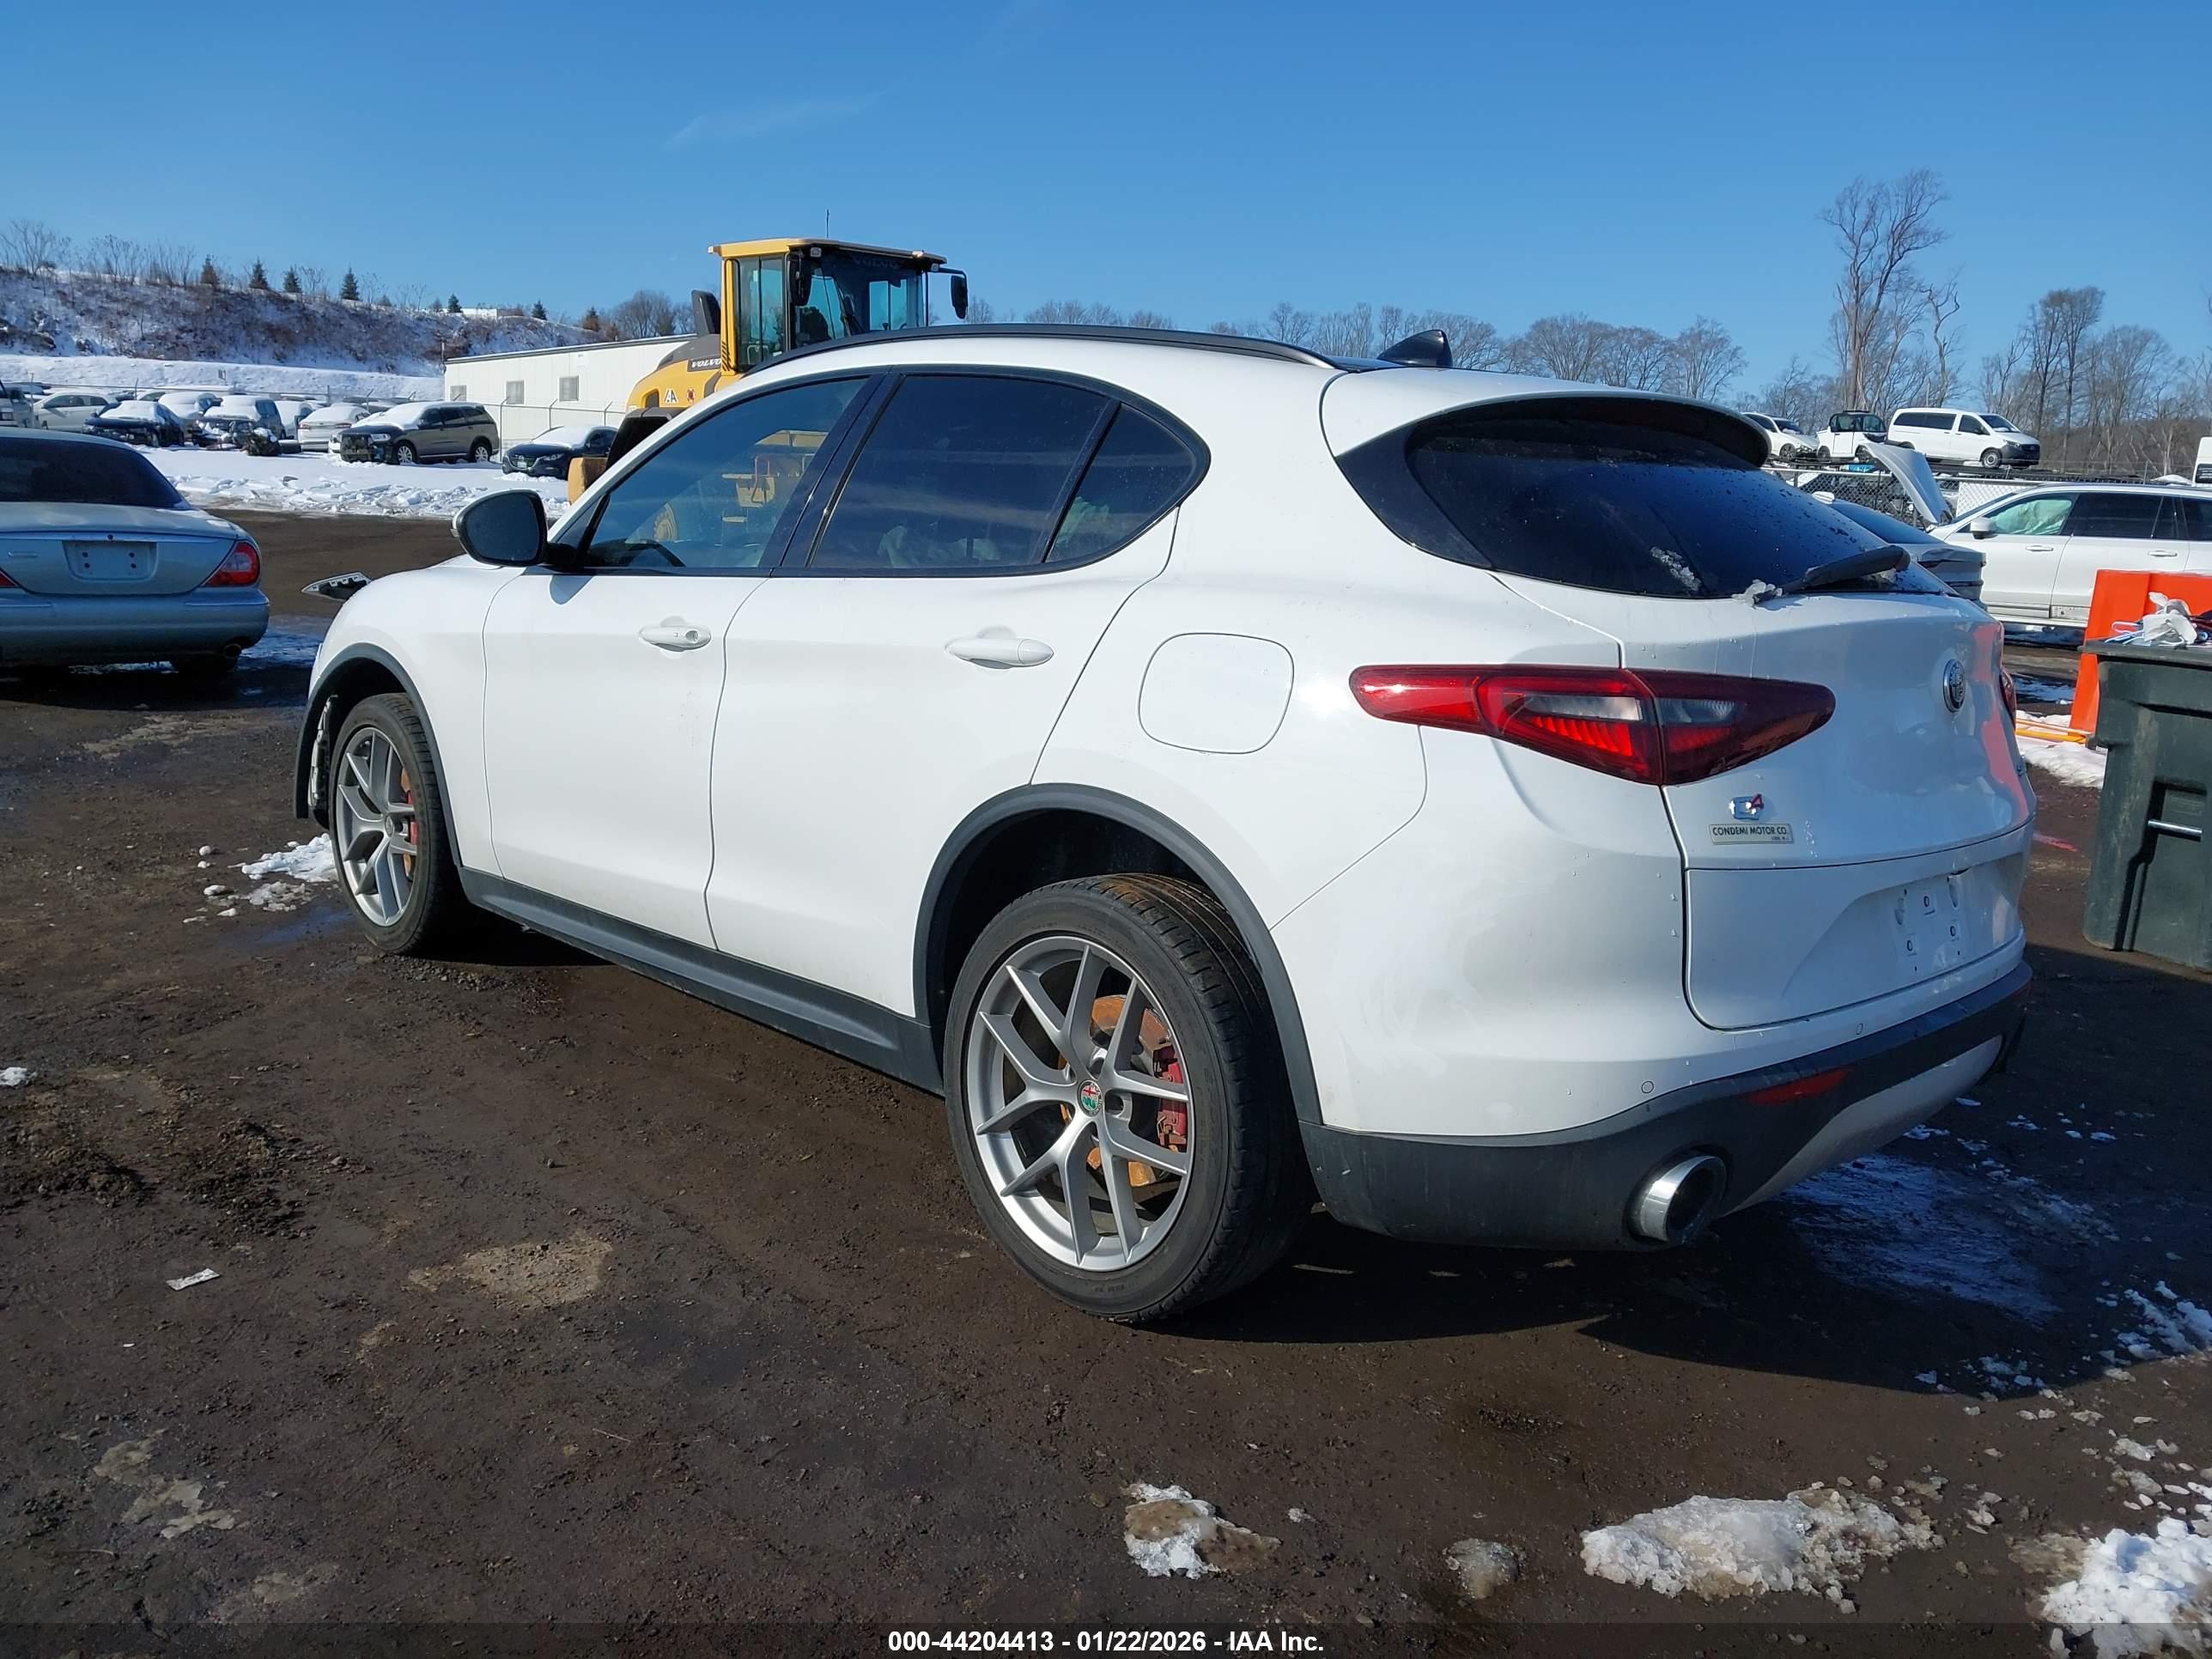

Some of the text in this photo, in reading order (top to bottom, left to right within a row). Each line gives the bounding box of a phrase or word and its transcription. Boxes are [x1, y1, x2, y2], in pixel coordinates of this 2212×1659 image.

[691, 357, 721, 368] VOLVO
[1712, 826, 1749, 836] CONDEMI
[1750, 826, 1775, 835] MOTOR
